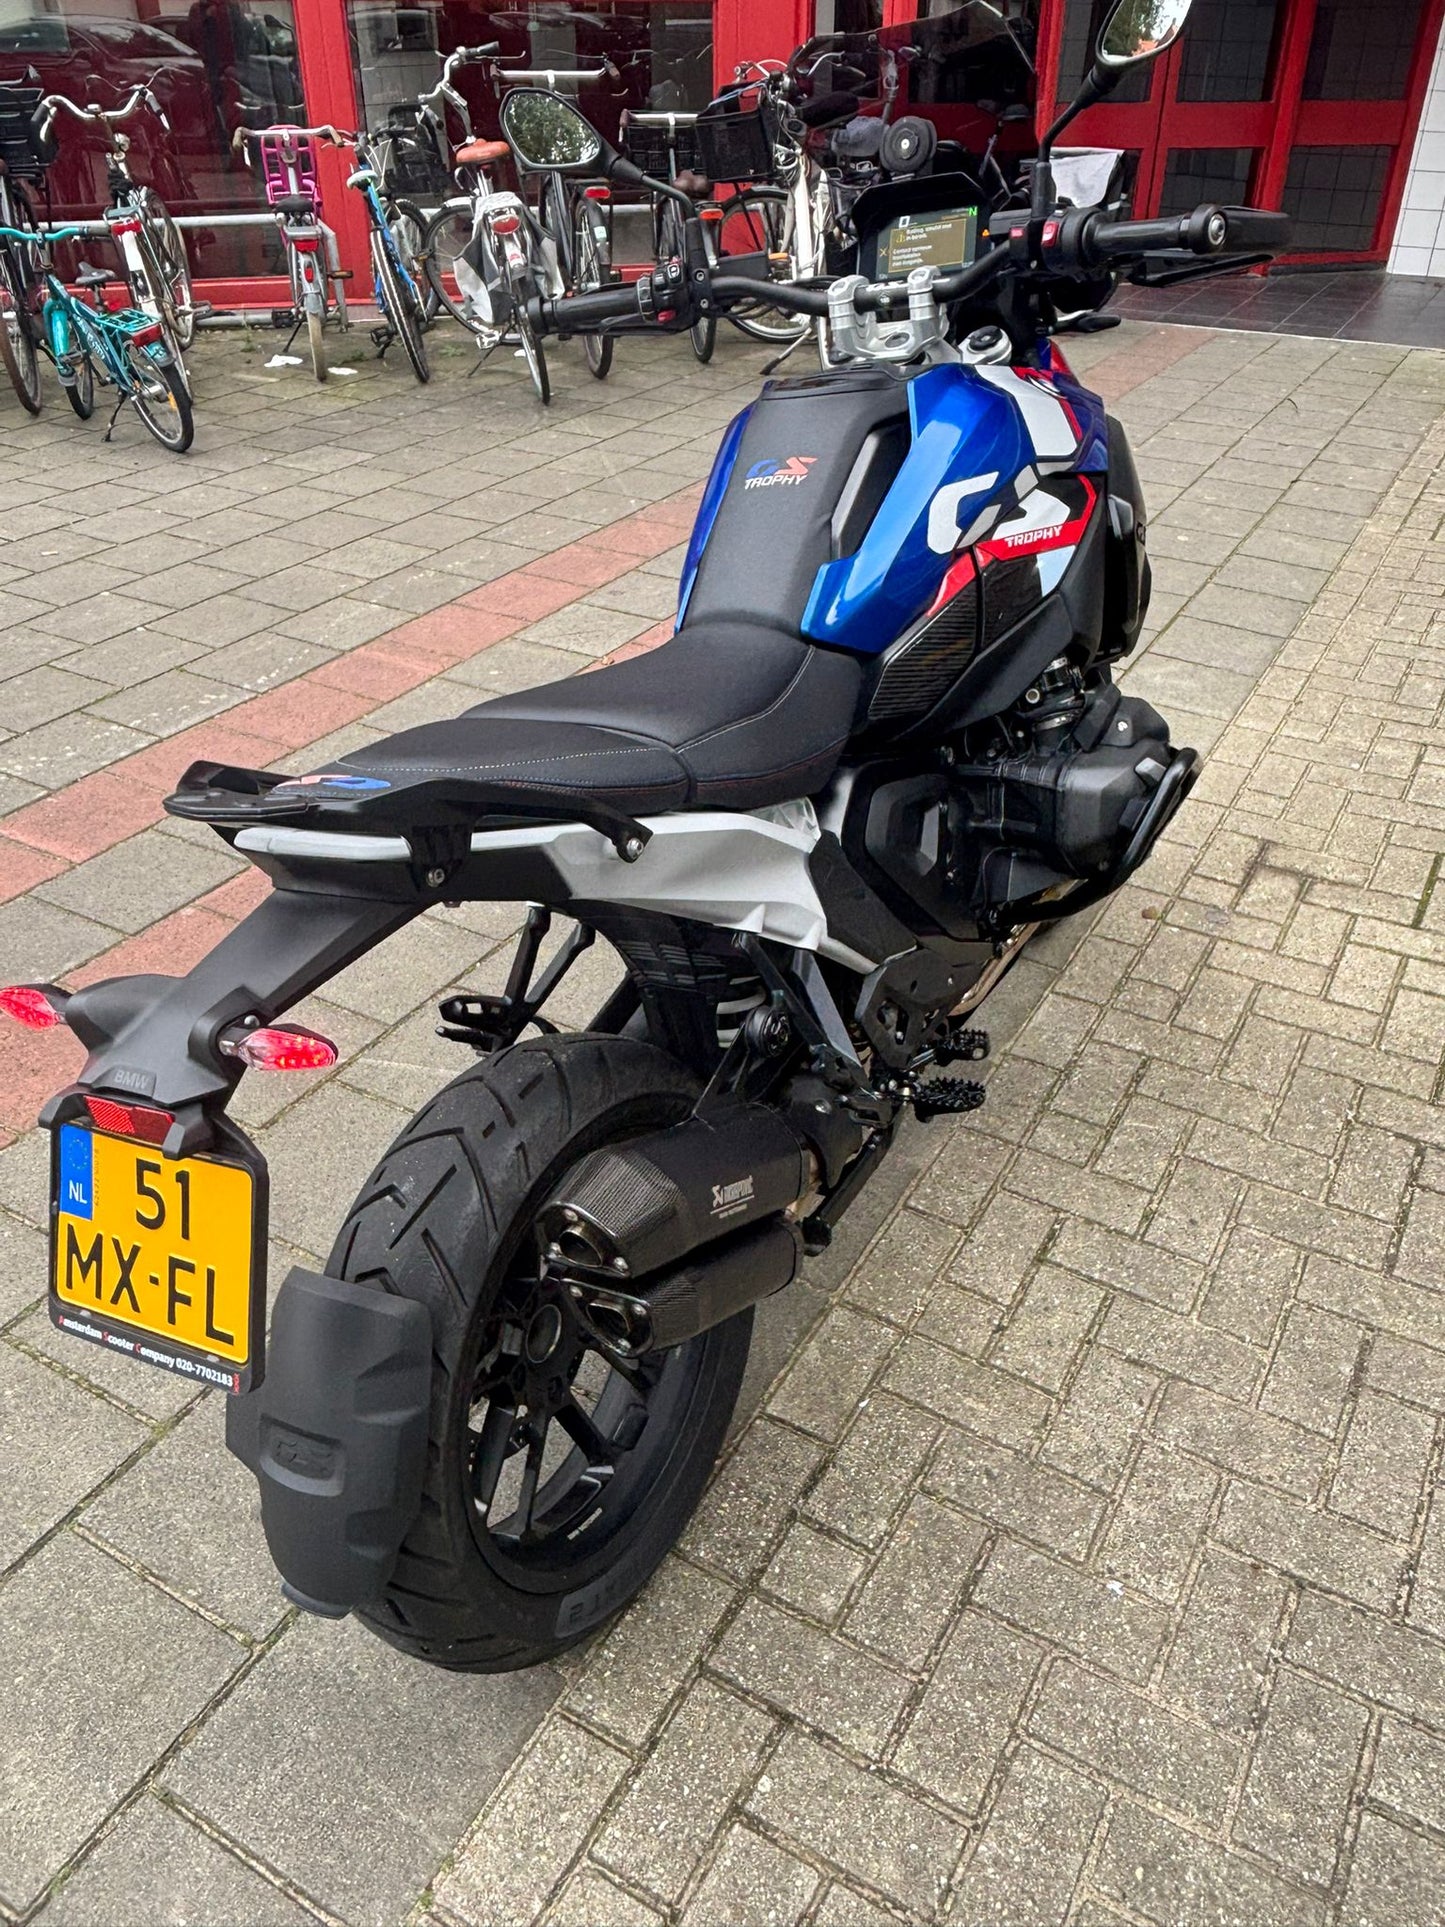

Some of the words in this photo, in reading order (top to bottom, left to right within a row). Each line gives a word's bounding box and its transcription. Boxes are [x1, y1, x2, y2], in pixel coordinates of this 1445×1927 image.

[968, 206, 978, 217] N
[744, 474, 808, 490] TROPHY
[1004, 525, 1063, 548] TROPHY
[114, 1069, 149, 1090] BMW
[68, 1180, 88, 1204] NL
[135, 1157, 191, 1241] 51
[58, 1314, 103, 1340] Amsterdam
[103, 1331, 135, 1352] Scooter
[135, 1343, 176, 1369] Company
[175, 1357, 234, 1387] 020-7702183
